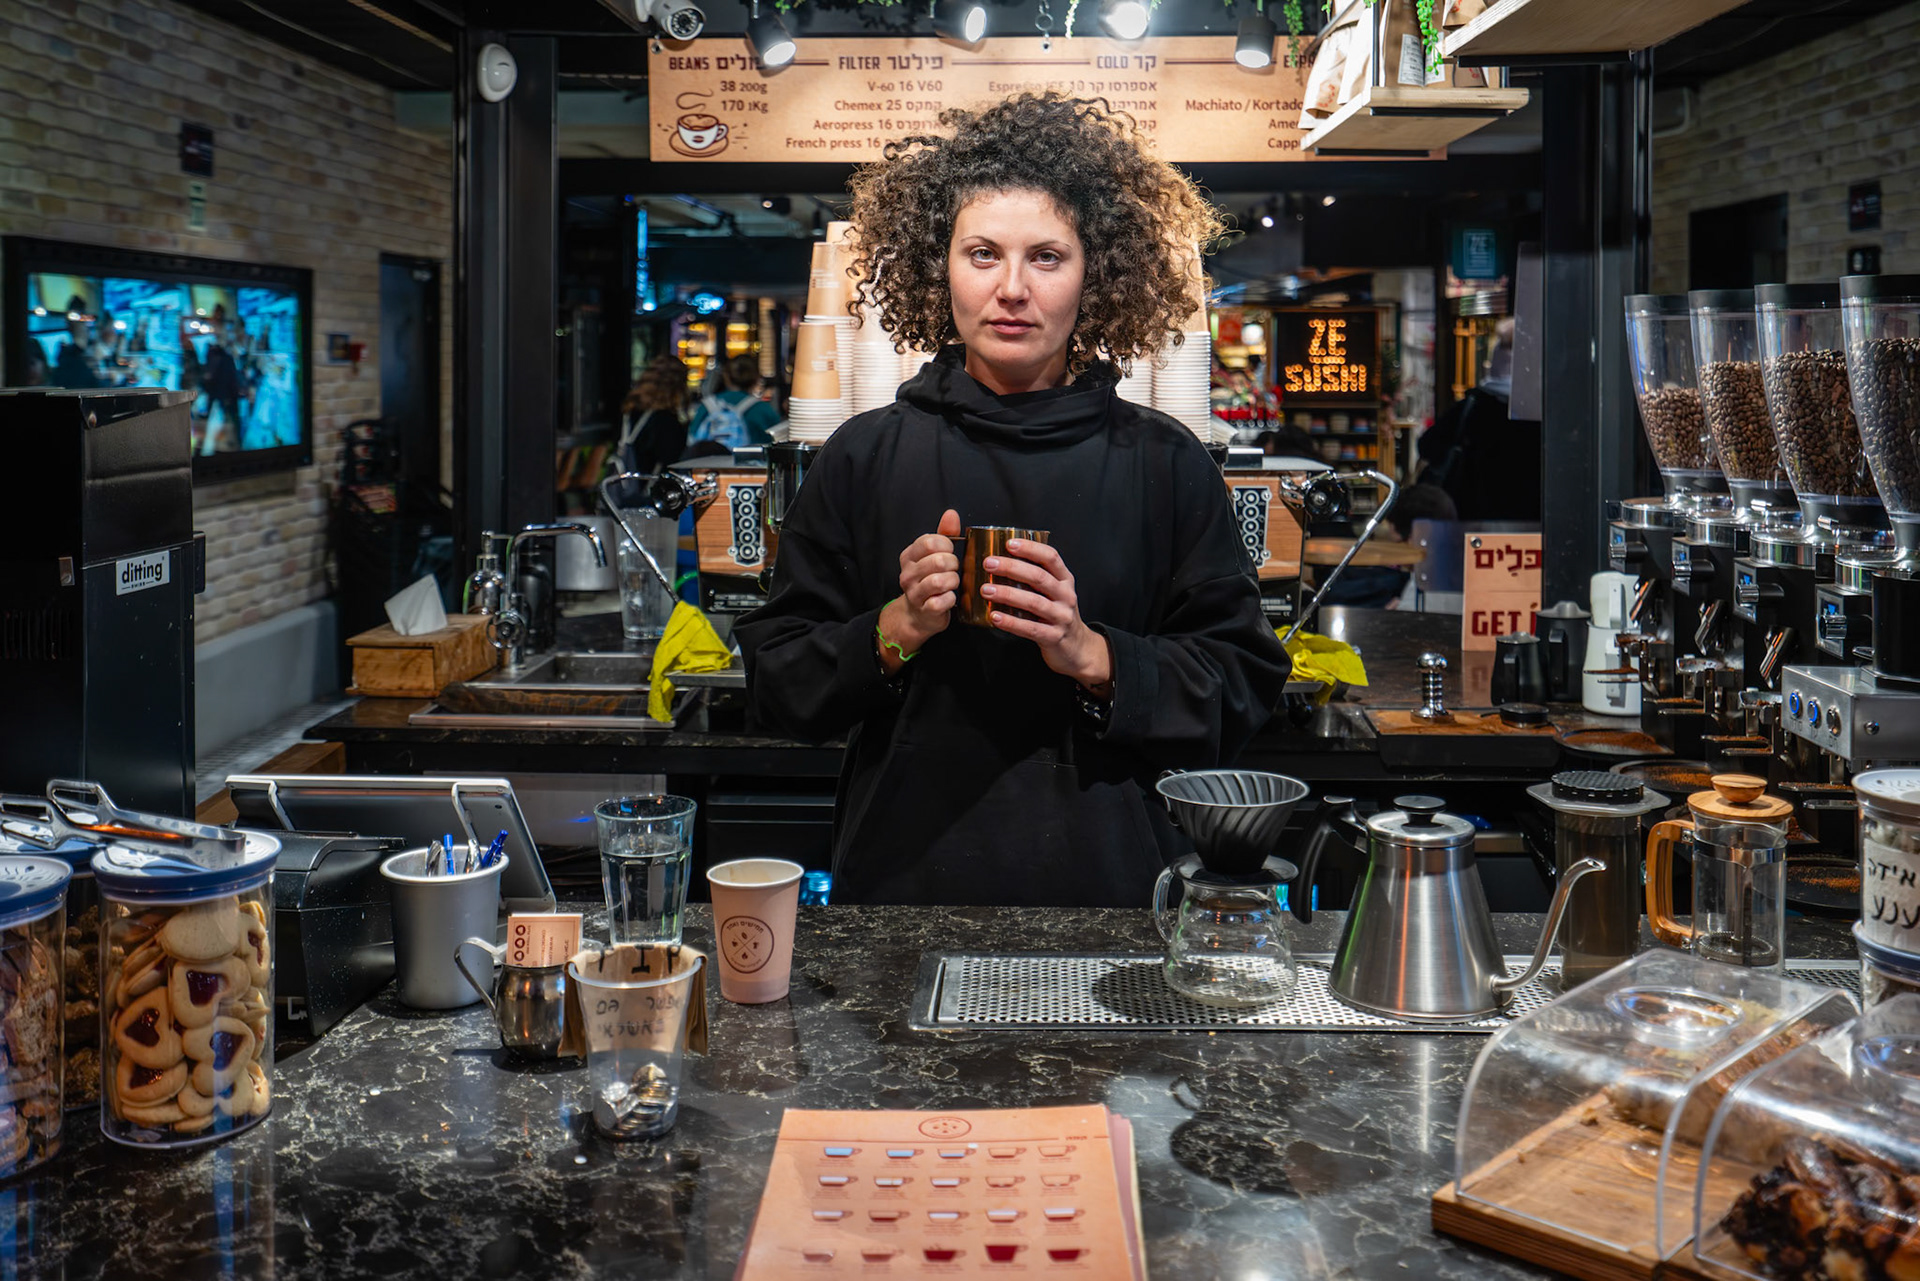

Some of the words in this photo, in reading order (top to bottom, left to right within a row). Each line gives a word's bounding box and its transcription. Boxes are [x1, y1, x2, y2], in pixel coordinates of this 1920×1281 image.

[669, 57, 709, 70] BEANS
[716, 53, 761, 70] ולים
[839, 56, 880, 70] FILTER
[887, 54, 943, 70] פילטר
[1097, 56, 1128, 69] COLD
[1134, 56, 1156, 72] קר
[720, 81, 736, 92] 38
[740, 83, 768, 94] 200g
[868, 81, 894, 92] V-60
[900, 80, 913, 91] 16
[918, 80, 942, 91] V60
[1089, 82, 1104, 93] קר
[1109, 81, 1157, 91] אספרסו
[722, 100, 744, 111] 170
[834, 100, 882, 111] Chemex
[886, 100, 901, 110] 25
[906, 101, 942, 112] קמקס
[1185, 99, 1242, 110] Machiato
[813, 120, 873, 132] Aeropress
[879, 119, 892, 129] 16
[786, 137, 826, 148] French
[830, 139, 861, 150] press
[867, 138, 880, 148] 16
[1268, 138, 1300, 150] Capp
[1309, 319, 1346, 356] ZE
[1285, 364, 1367, 392] SUSHI
[122, 560, 162, 584] ditting
[1472, 611, 1522, 636] GET
